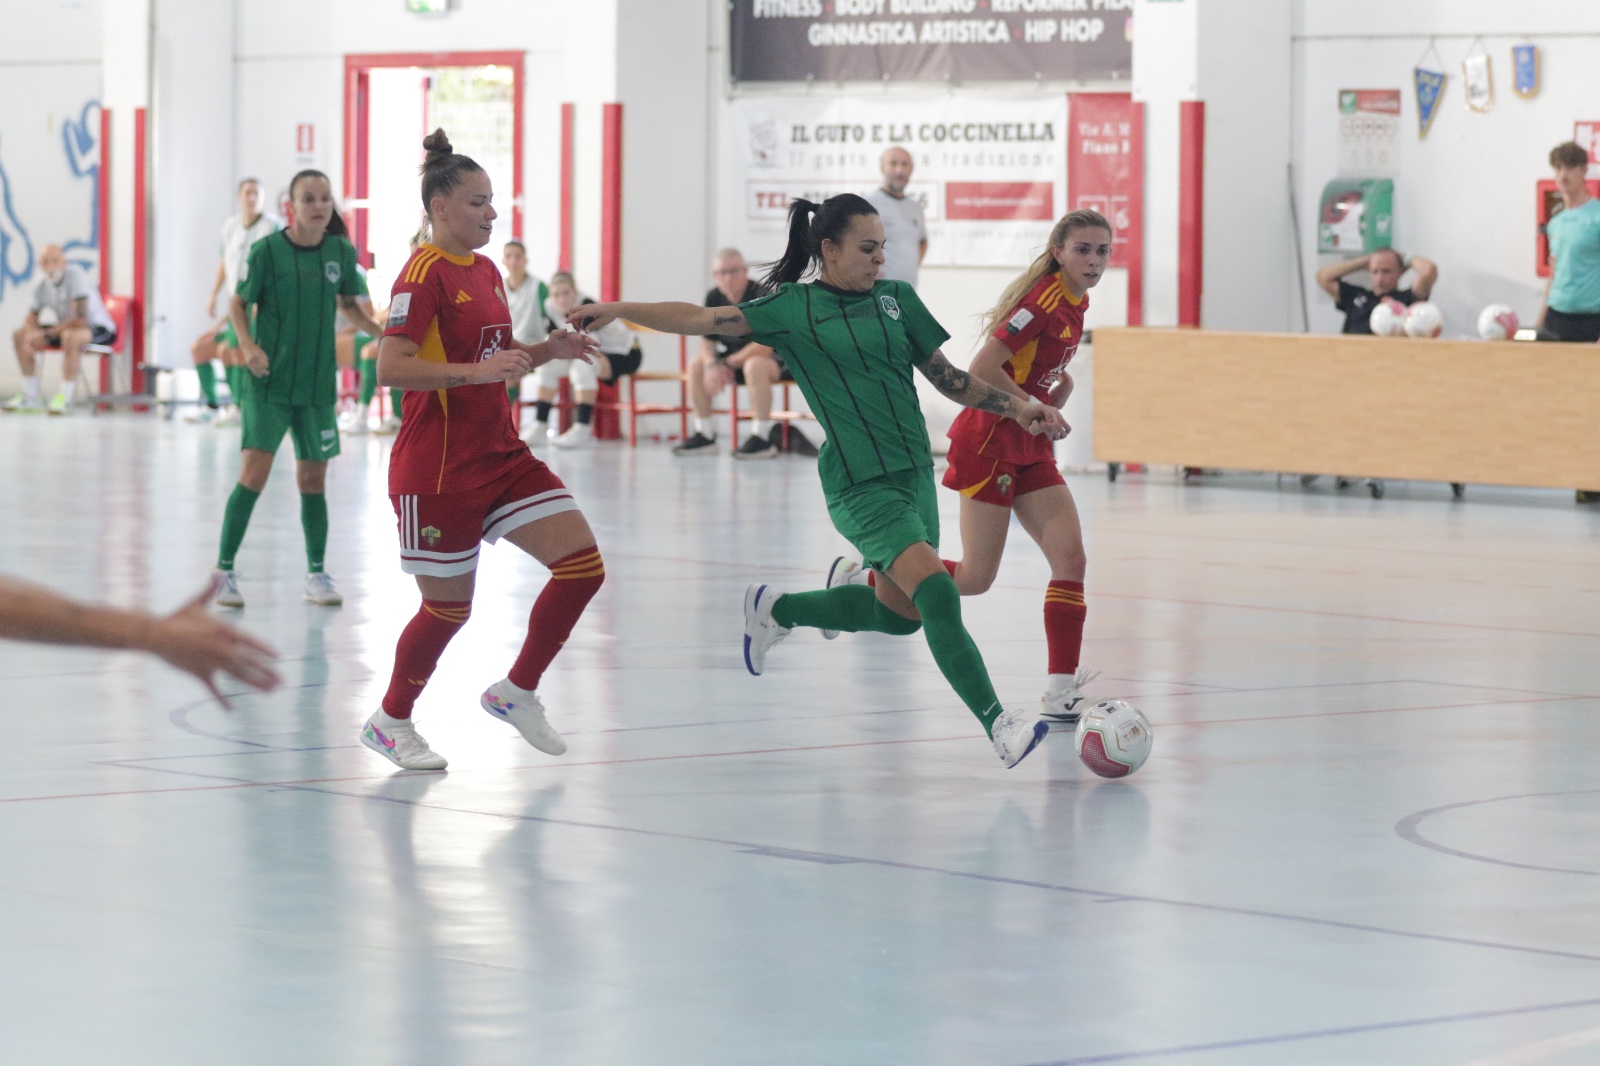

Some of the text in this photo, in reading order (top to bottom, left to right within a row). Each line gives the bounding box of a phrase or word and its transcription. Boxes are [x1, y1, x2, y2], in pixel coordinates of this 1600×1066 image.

[752, 0, 822, 18] FITNESS
[834, 0, 883, 16] BODY
[807, 17, 1104, 46] GINNASTICA ARTISTICA HIP HOP
[791, 122, 1055, 142] IL GUFO E LA COCCINELLA
